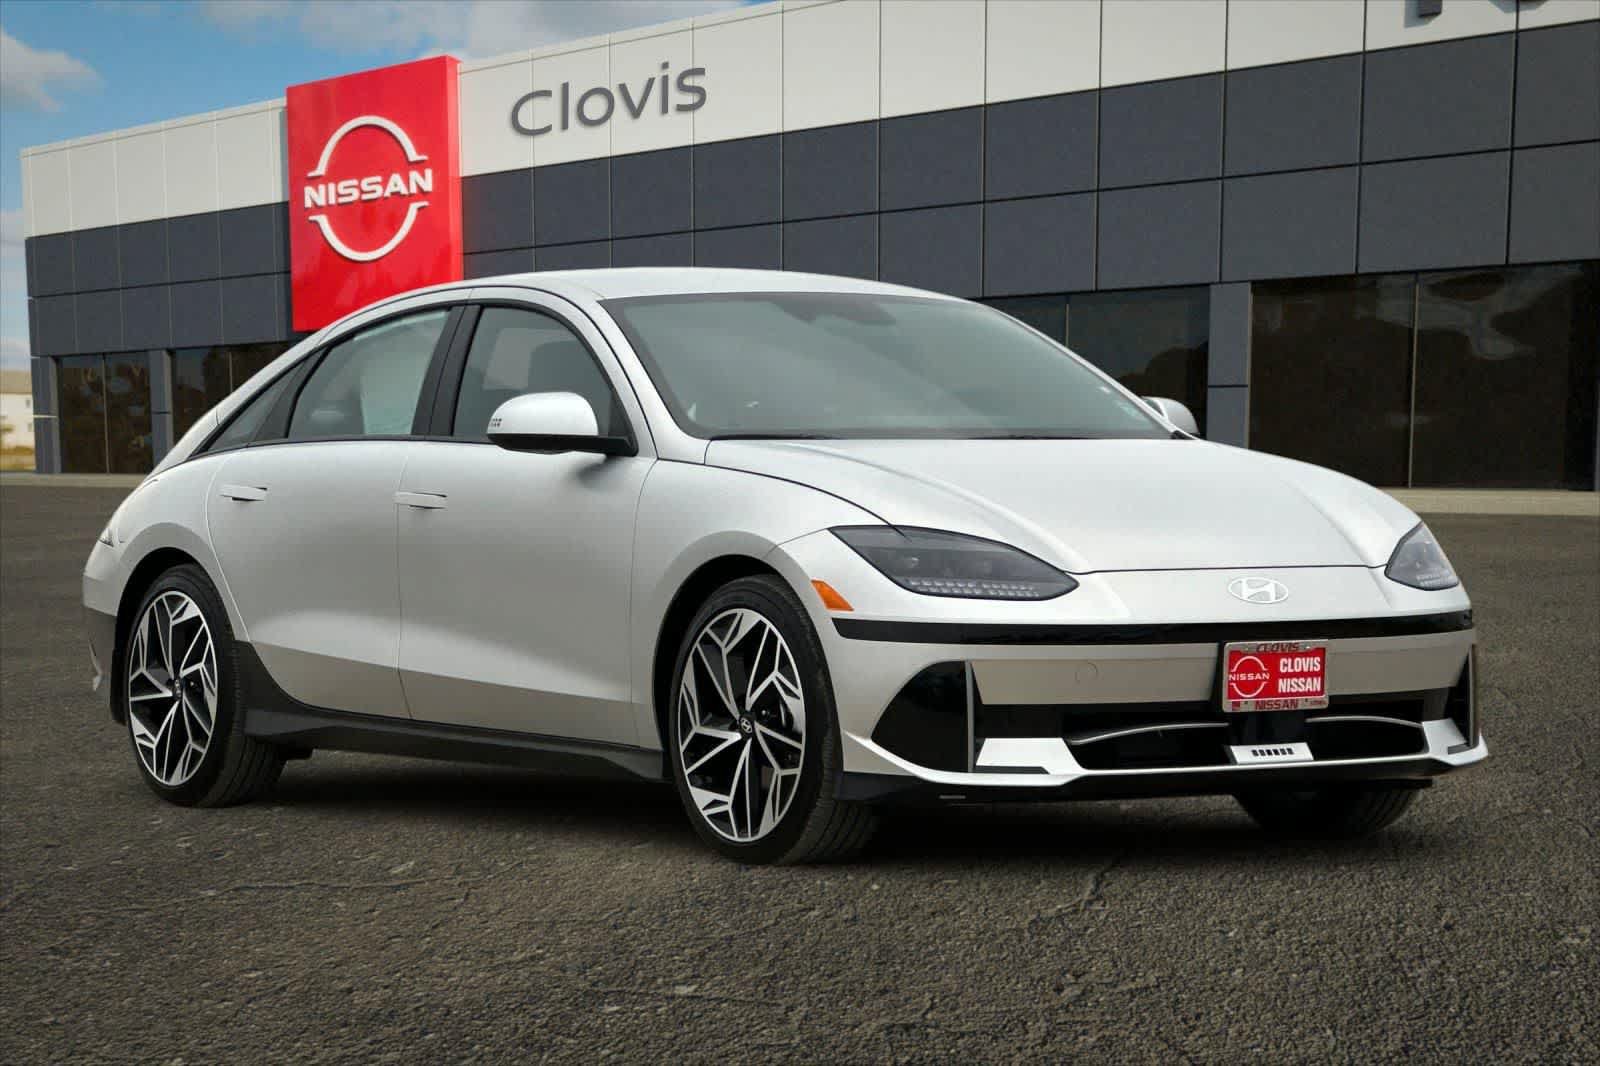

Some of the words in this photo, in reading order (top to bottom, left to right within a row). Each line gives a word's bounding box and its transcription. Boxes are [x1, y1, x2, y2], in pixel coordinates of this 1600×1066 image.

[511, 61, 707, 136] Clovis
[303, 168, 433, 208] NISSAN
[1256, 642, 1300, 652] CLOVIS
[1279, 656, 1321, 673] CLOVIS
[1228, 672, 1270, 681] NISSAN
[1278, 677, 1321, 693] NISSAN
[1255, 699, 1298, 710] NISSAN
